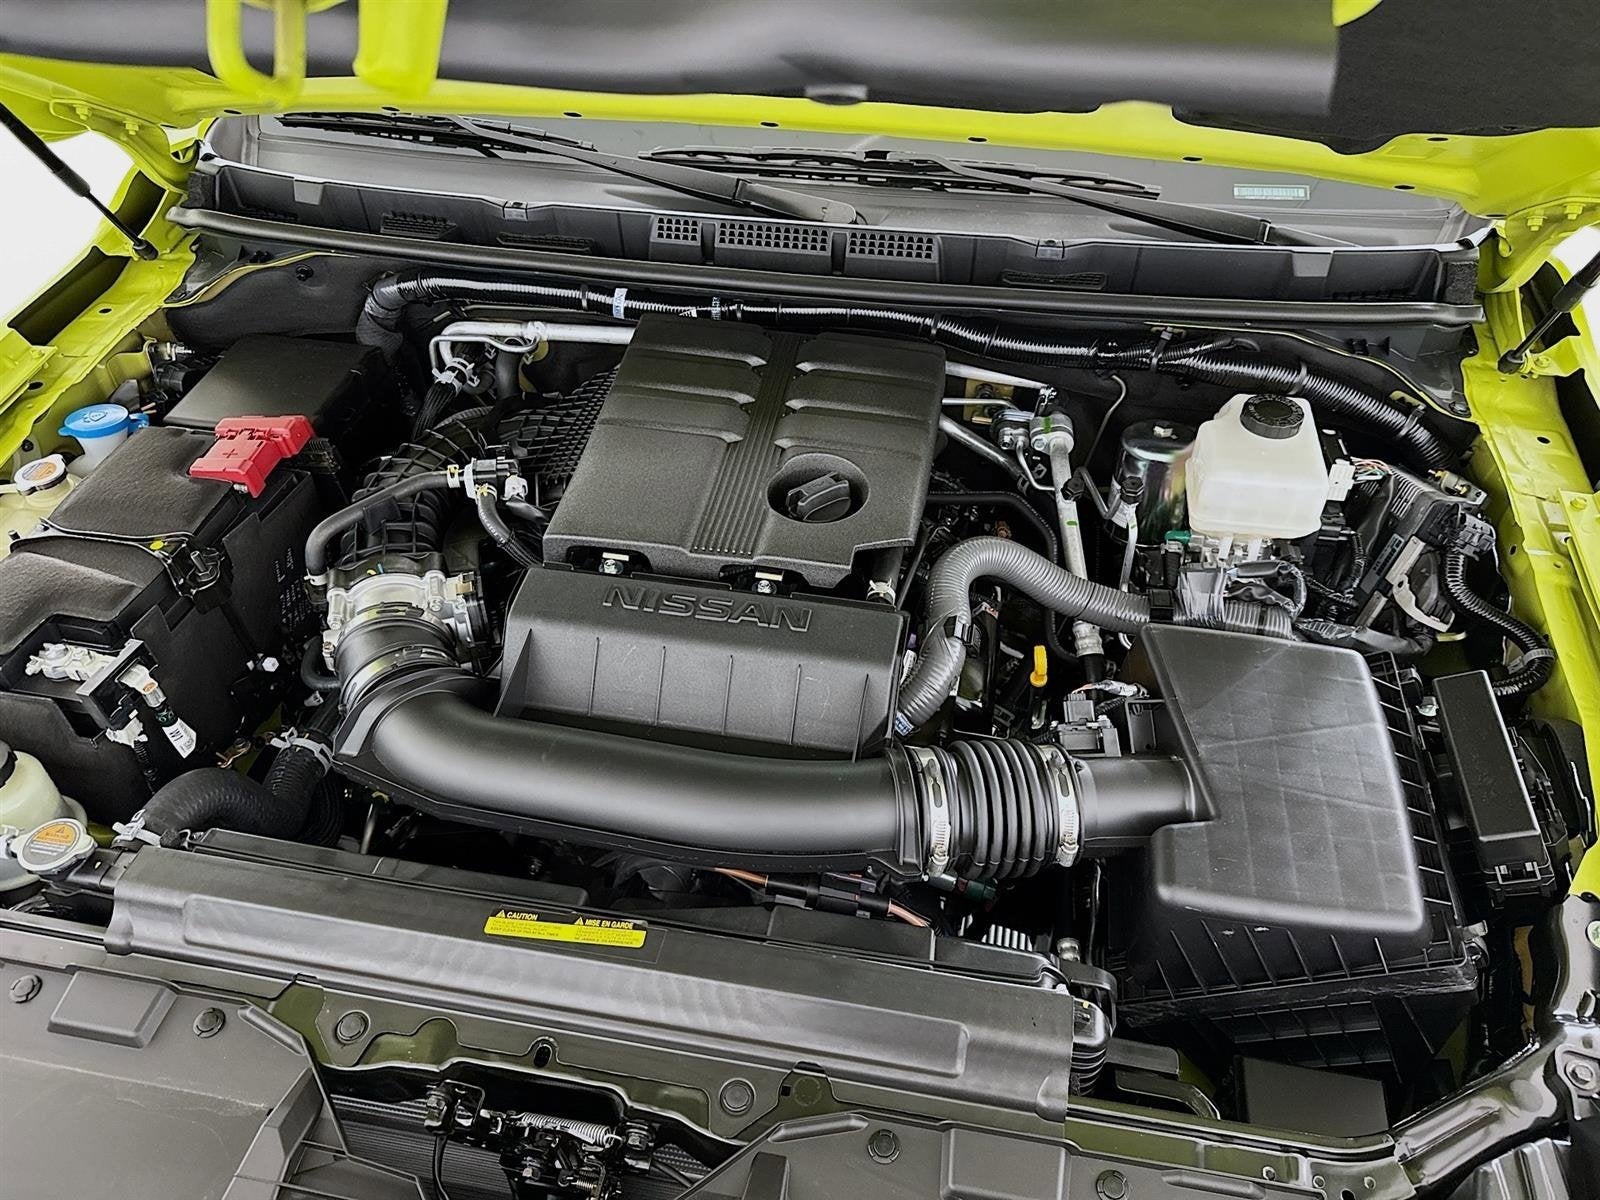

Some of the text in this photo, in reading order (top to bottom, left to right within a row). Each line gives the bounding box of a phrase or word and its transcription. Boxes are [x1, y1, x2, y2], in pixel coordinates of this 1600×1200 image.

[602, 584, 813, 633] NISSAN
[506, 911, 539, 921] CAUTION
[584, 918, 634, 930] MISE EN GARDE
